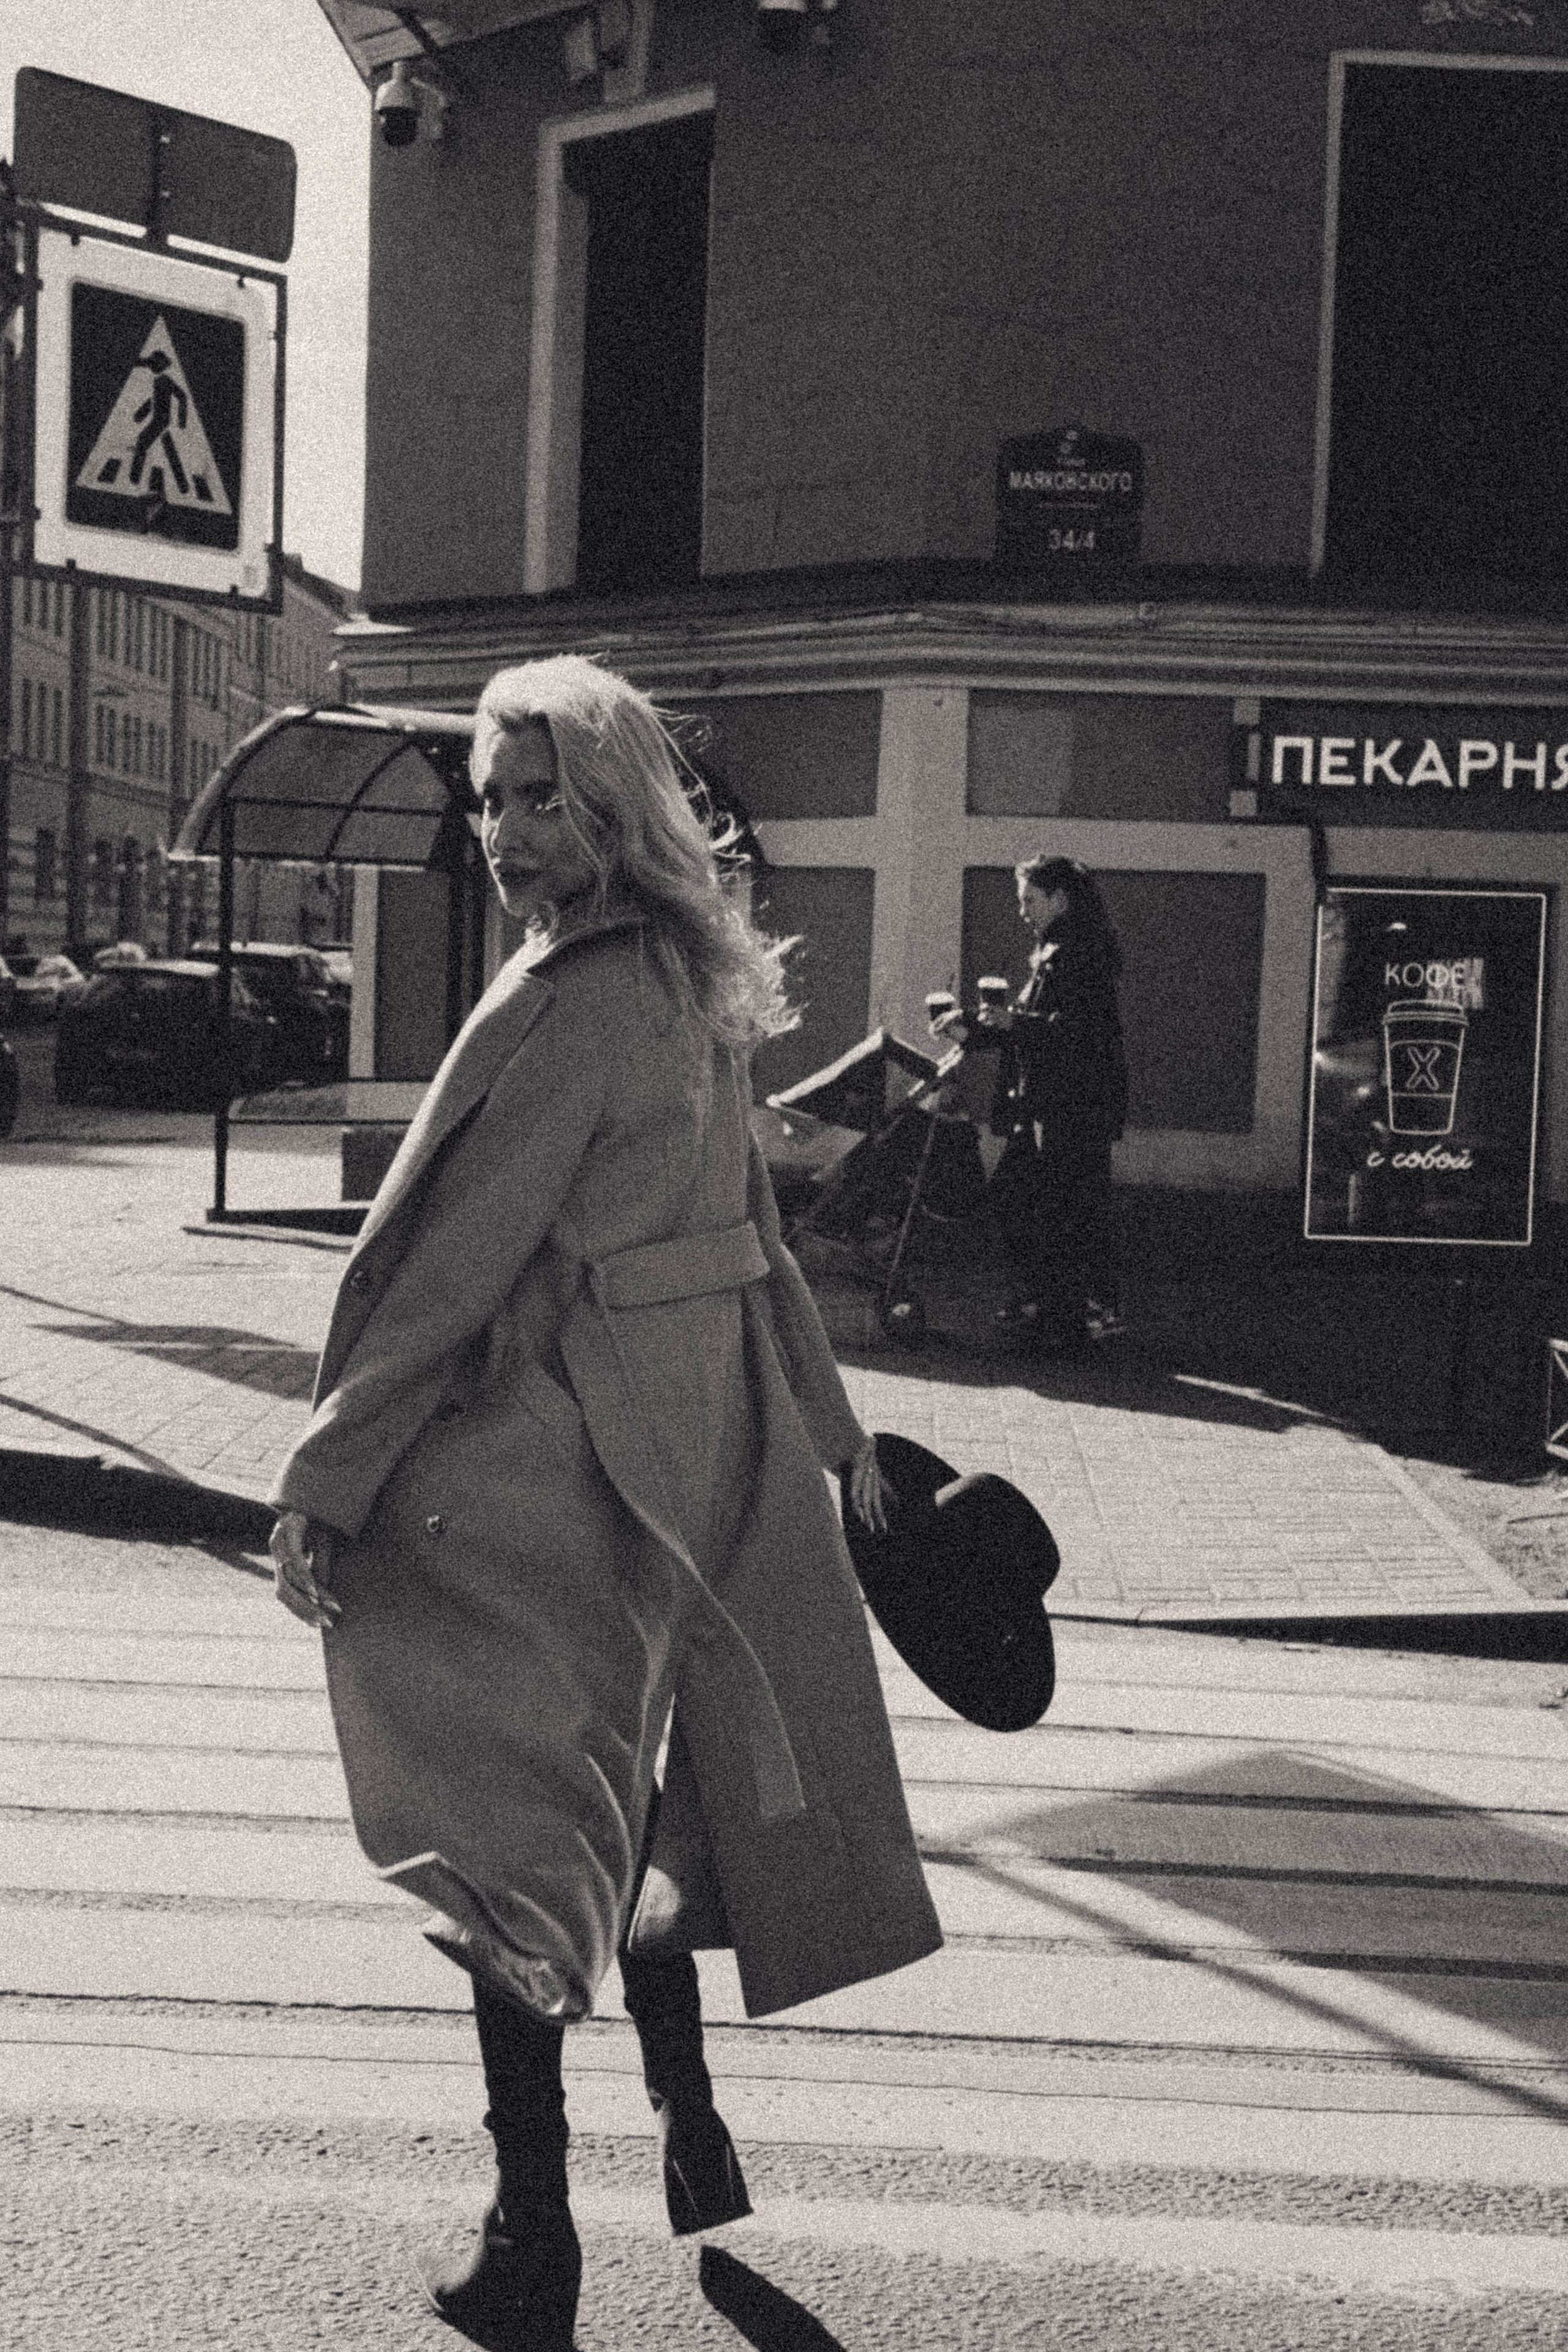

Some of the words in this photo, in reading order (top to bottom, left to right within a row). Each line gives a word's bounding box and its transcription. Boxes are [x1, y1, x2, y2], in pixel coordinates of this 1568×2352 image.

[1009, 470, 1133, 491] МАЯКОВСКОГО
[1385, 962, 1464, 988] КОФЕ
[1391, 1144, 1474, 1170] собой
